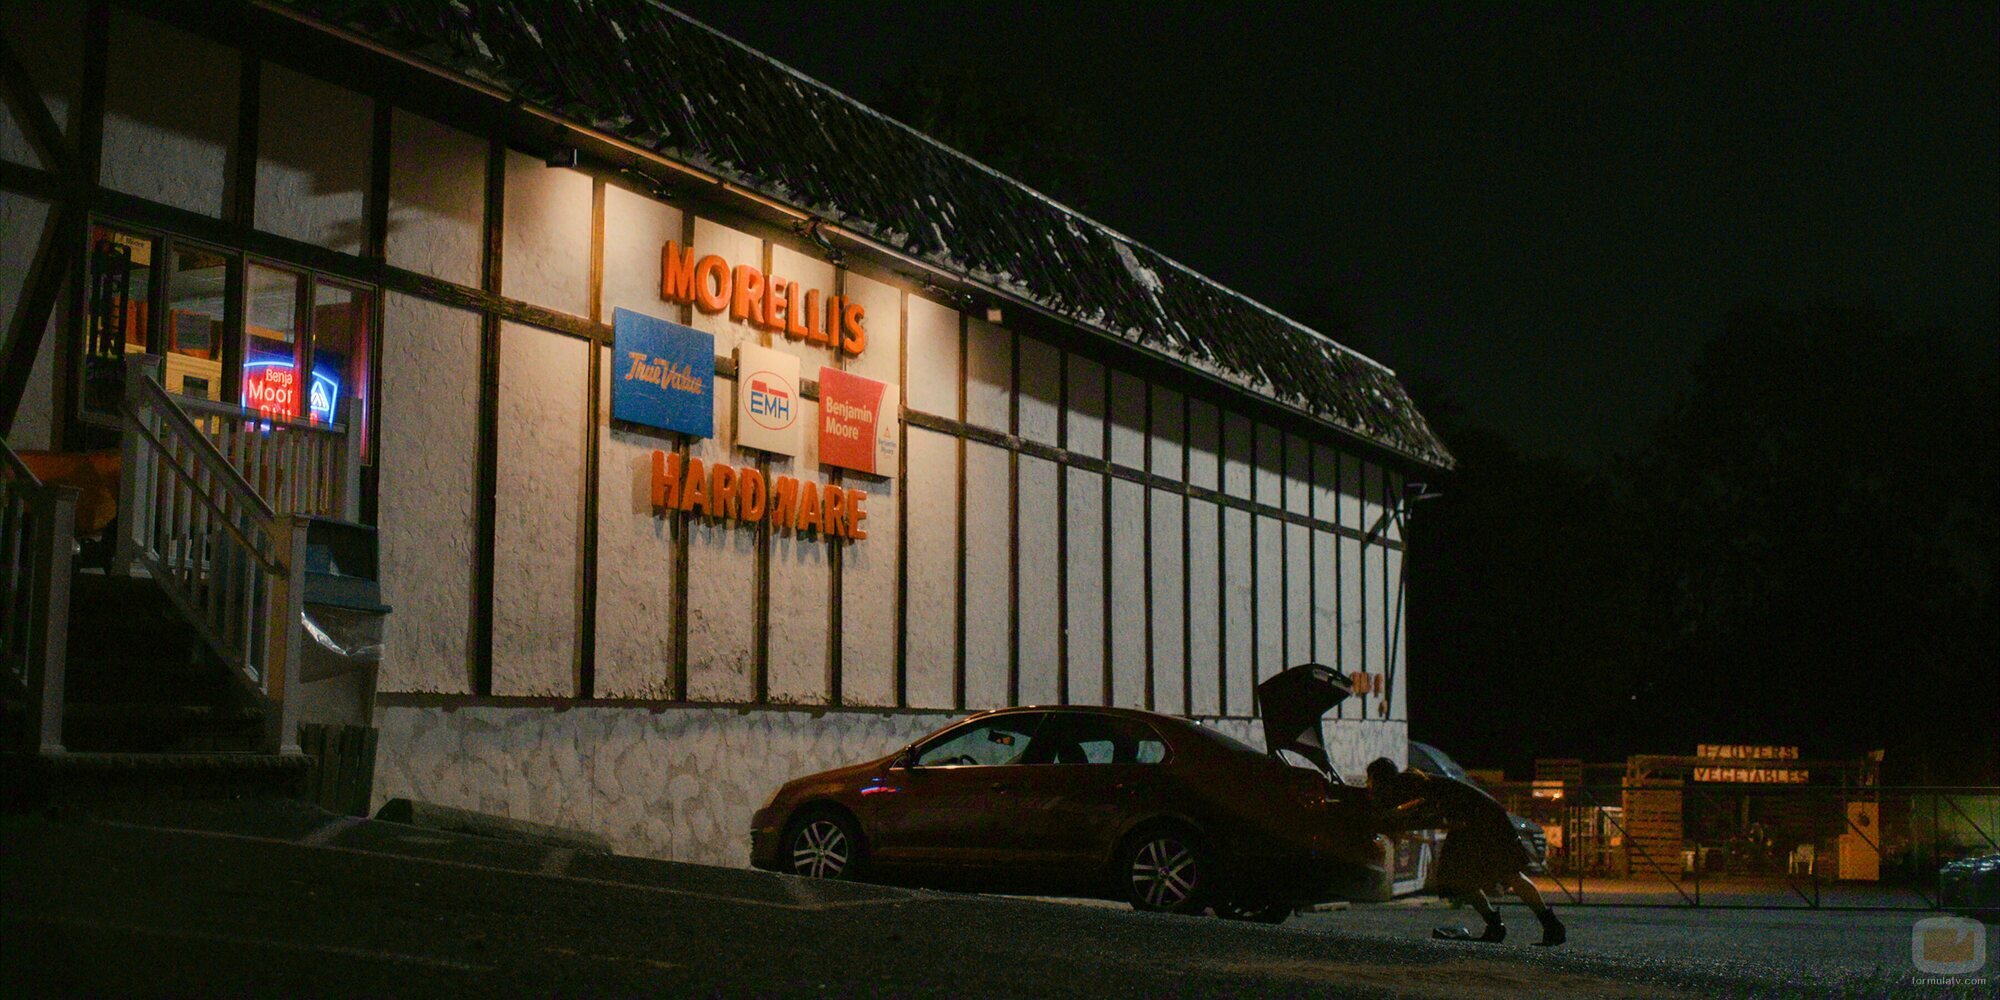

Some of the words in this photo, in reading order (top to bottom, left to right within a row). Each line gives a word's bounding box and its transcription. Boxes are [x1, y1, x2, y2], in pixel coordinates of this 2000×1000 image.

[661, 239, 866, 356] MORELLI'S
[265, 368, 293, 387] Benja
[625, 352, 660, 385] True
[654, 358, 704, 395] Value
[249, 379, 293, 404] Moor
[751, 391, 789, 420] EMH
[826, 396, 873, 424] Benjamin
[825, 416, 859, 440] Moore
[651, 450, 868, 540] HARDWARE
[1695, 767, 1808, 783] VEGETABLES
